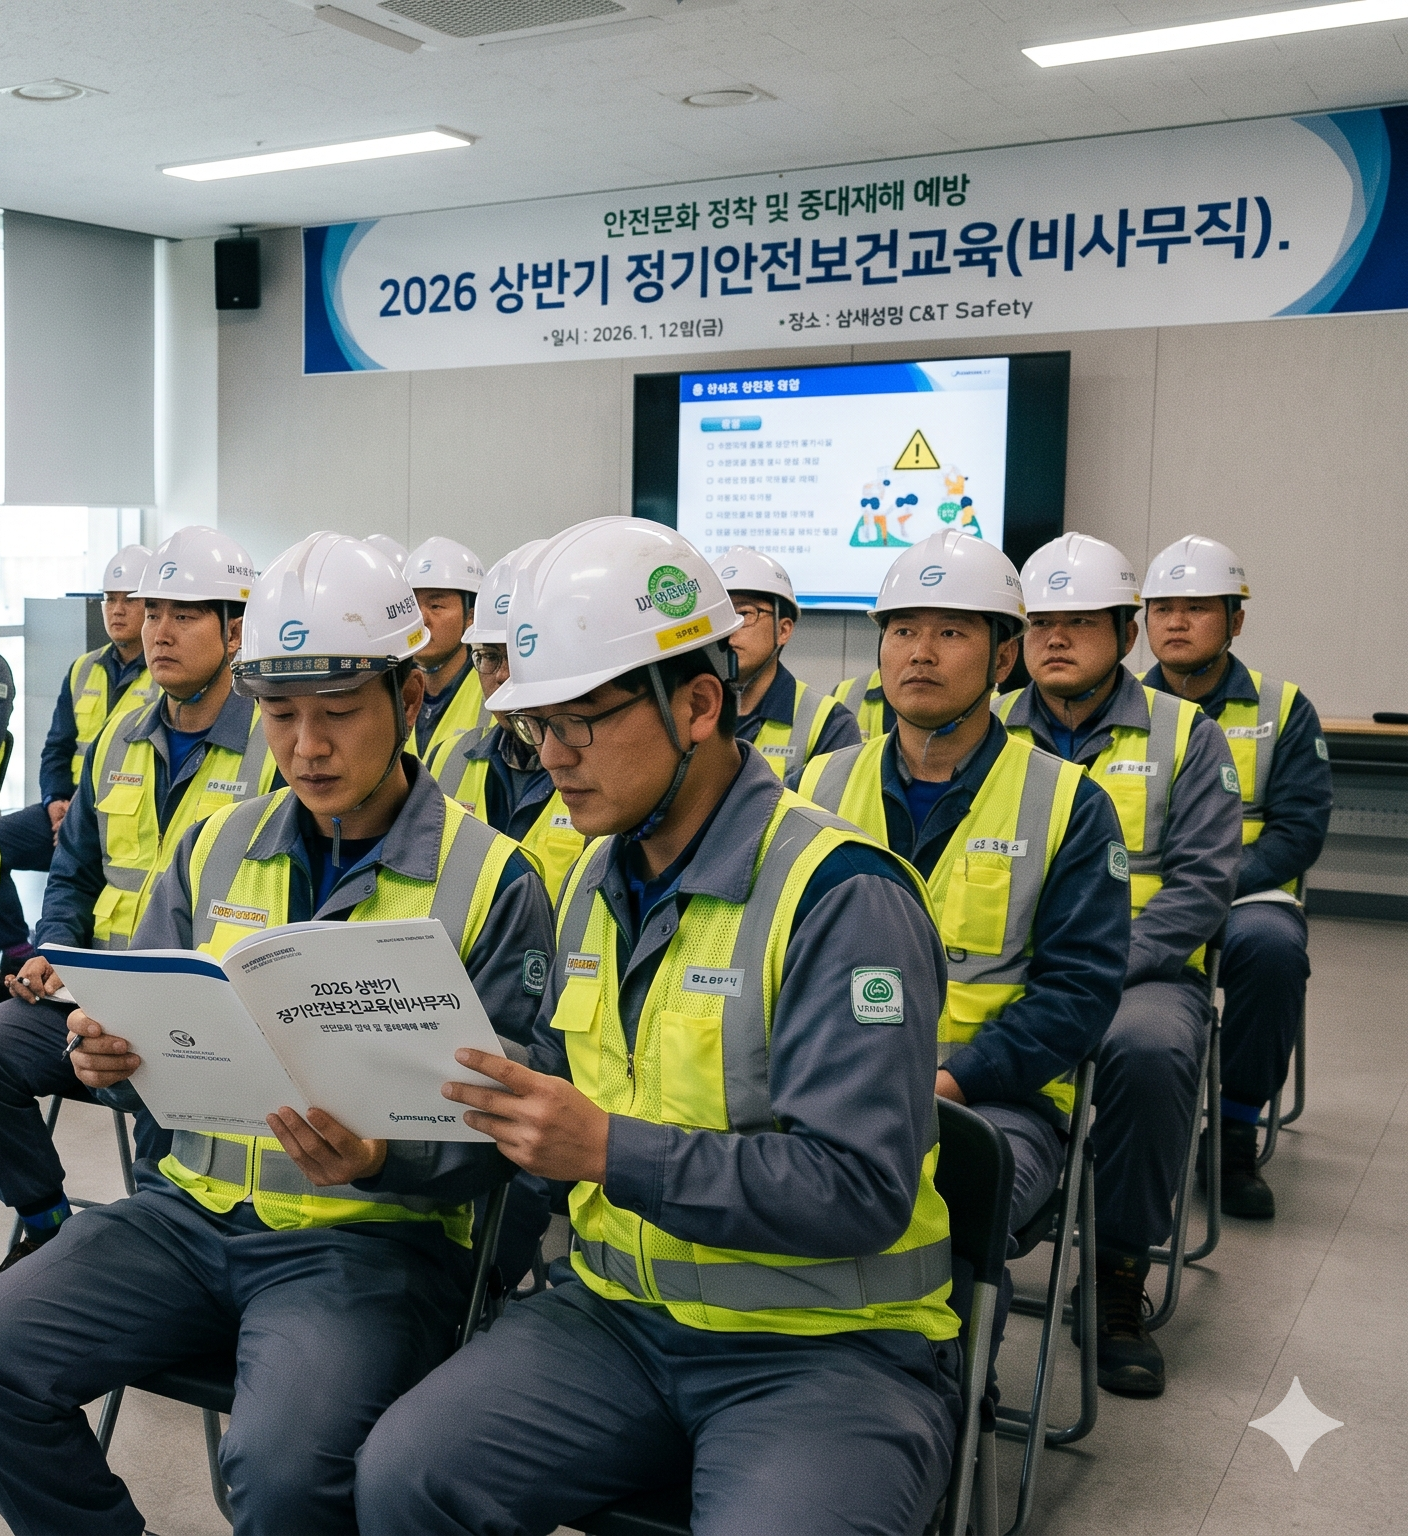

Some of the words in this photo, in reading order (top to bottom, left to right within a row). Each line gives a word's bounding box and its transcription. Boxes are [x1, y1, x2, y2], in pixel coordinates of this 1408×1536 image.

[603, 200, 701, 239] 안전문화
[707, 194, 759, 230] 정착
[765, 190, 790, 224] 및
[797, 178, 906, 222] 중대재해
[912, 172, 972, 210] 예방
[379, 271, 478, 318] 2026
[488, 253, 610, 315] 상반기
[625, 194, 1291, 304] 정기안전보건교육(비사무직).
[908, 303, 950, 323] C&T
[954, 298, 1034, 320] Safety
[310, 981, 353, 996] 2026
[354, 977, 401, 995] 상반기
[275, 992, 462, 1025] 정기안전보건교육(비사무직)
